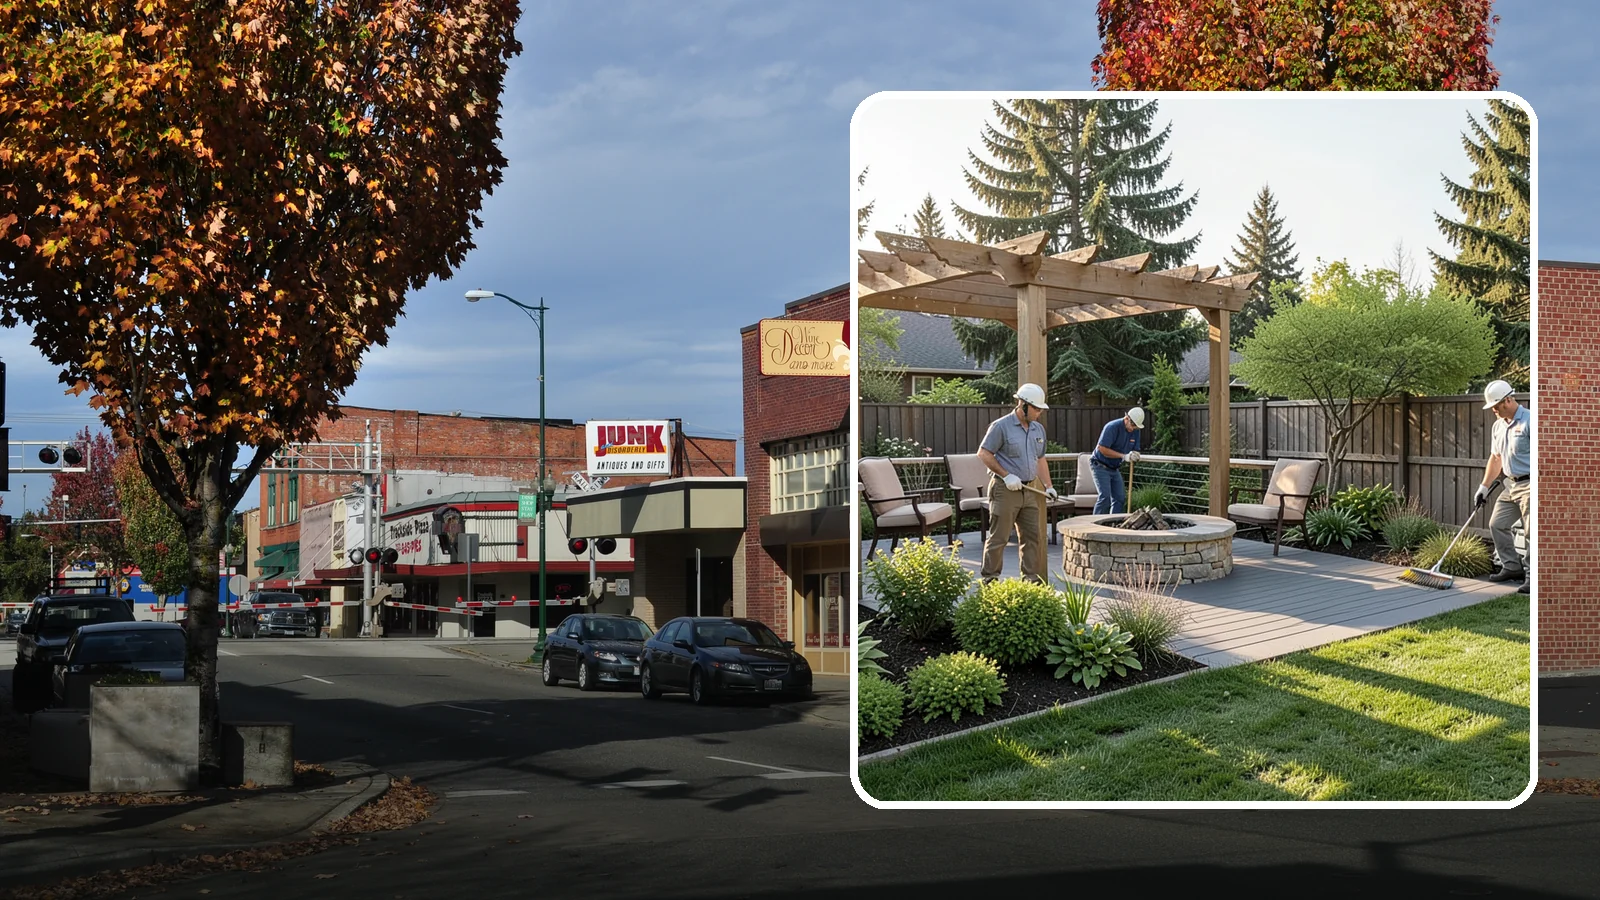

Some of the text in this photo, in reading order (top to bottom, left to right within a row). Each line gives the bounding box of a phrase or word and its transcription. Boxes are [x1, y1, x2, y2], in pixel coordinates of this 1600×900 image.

[595, 425, 665, 457] JUNK
[607, 446, 646, 454] DISORDERLY
[597, 460, 665, 470] ANTIQUES AND GIFTS
[390, 519, 429, 540] Trackside Pizza
